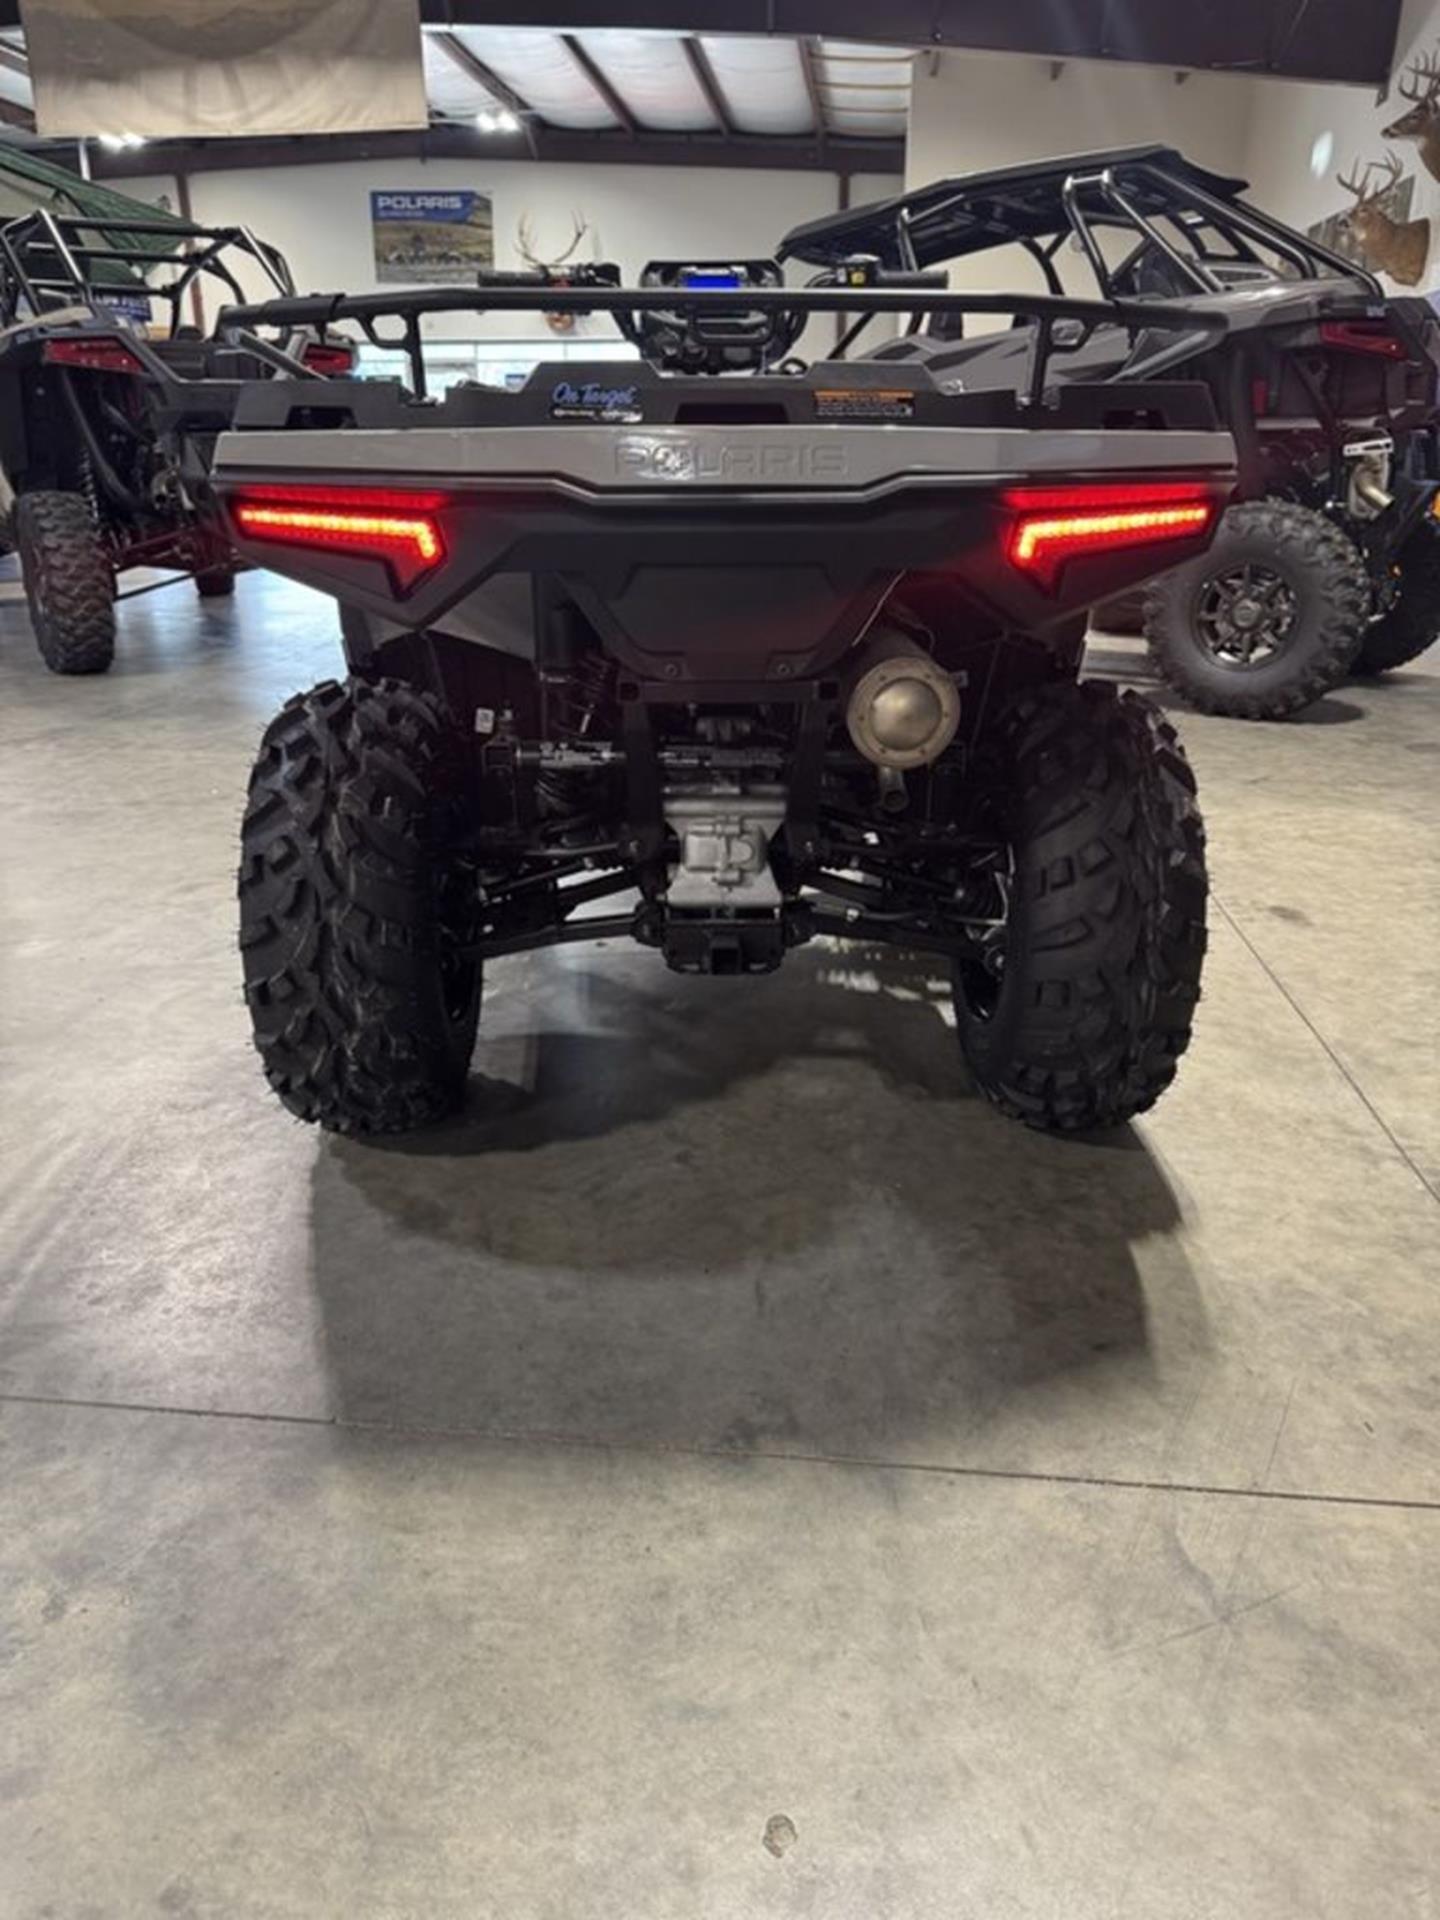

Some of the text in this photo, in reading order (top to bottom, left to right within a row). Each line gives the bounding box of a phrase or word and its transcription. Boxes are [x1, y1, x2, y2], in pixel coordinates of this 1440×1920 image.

[377, 195, 463, 209] POLARIS
[552, 381, 579, 404] On
[614, 444, 849, 476] POLARIS
